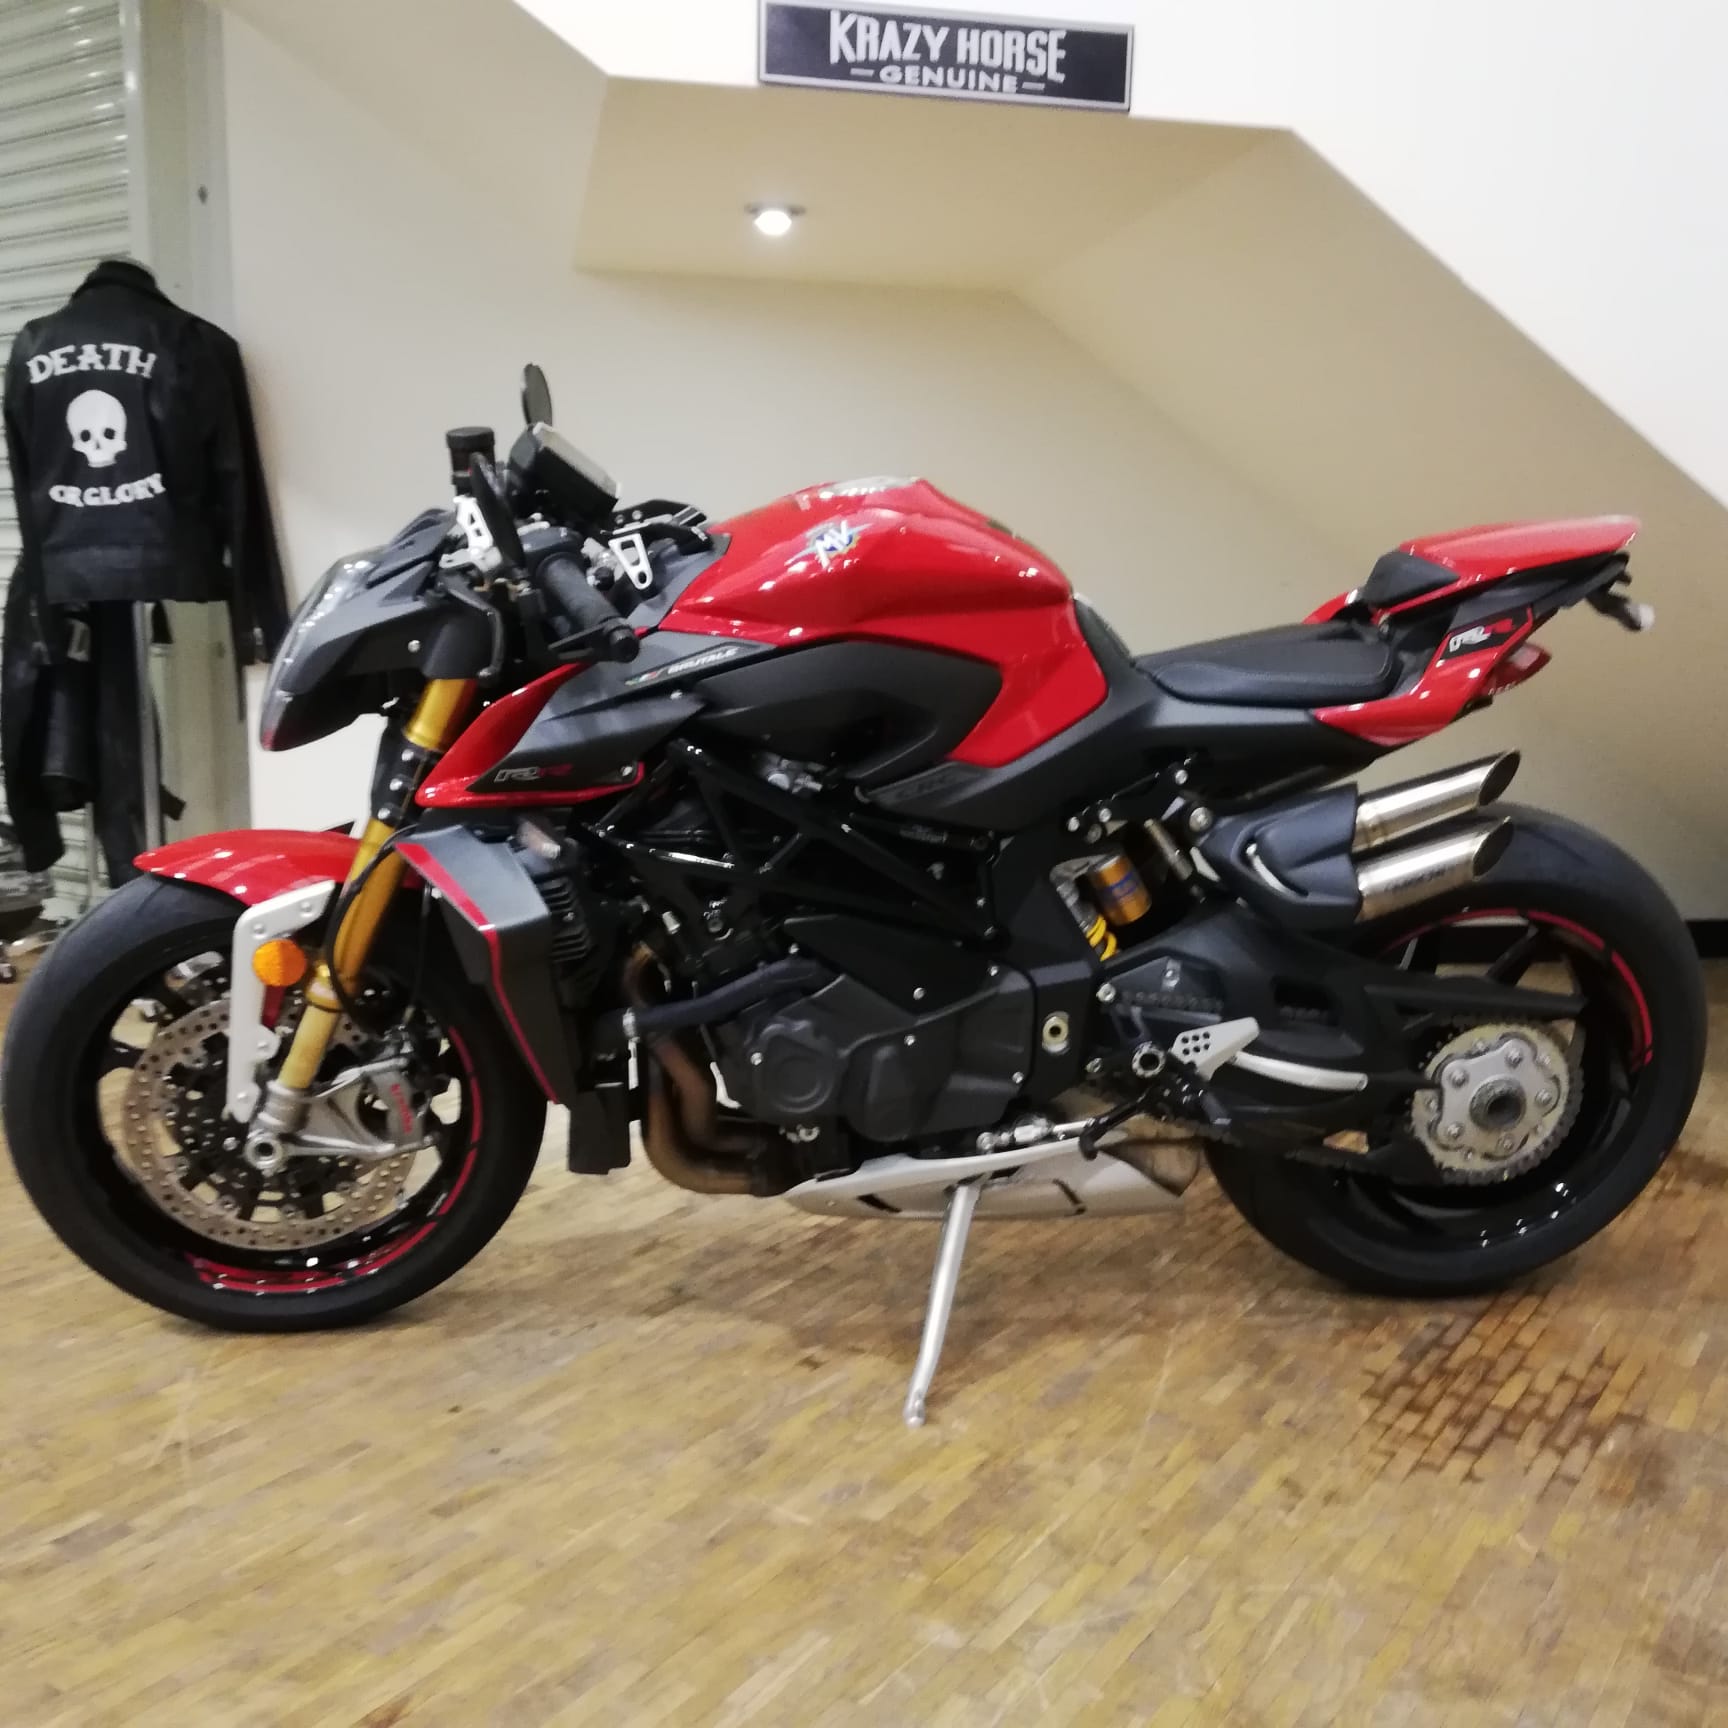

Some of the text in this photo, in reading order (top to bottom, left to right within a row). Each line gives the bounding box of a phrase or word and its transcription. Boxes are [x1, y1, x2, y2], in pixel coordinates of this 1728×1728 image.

[829, 9, 1067, 83] KRAZY HORSE
[879, 65, 1018, 93] GENUINE
[26, 343, 157, 384] DEATH
[83, 473, 166, 506] GLORY
